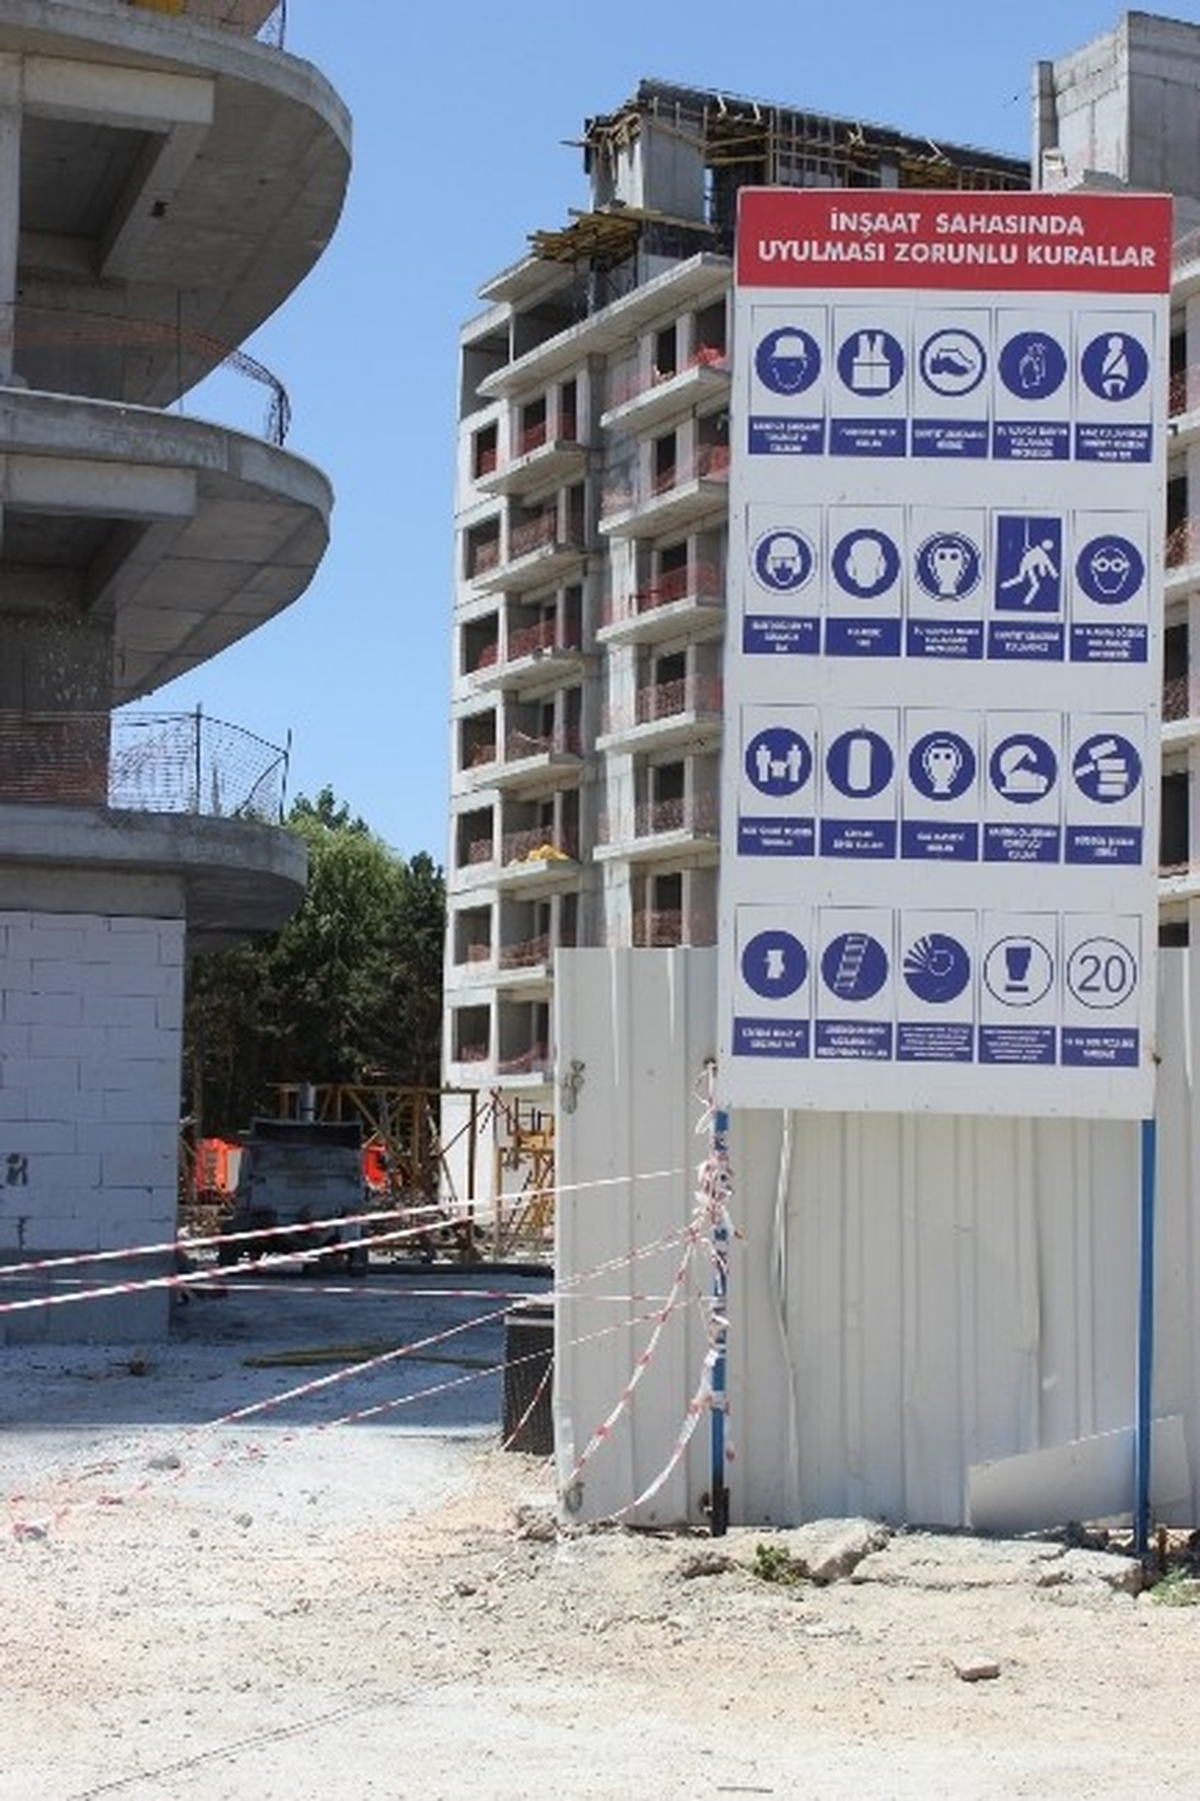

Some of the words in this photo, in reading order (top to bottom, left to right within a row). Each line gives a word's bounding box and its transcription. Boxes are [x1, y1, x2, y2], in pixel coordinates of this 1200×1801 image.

[830, 207, 921, 238] İNŞAAT
[935, 212, 1085, 236] SAHASINDA
[758, 240, 885, 262] UYULMASI
[894, 243, 1018, 264] ZORUNLU
[1027, 245, 1156, 267] KURALLAR
[1078, 954, 1127, 993] 20
